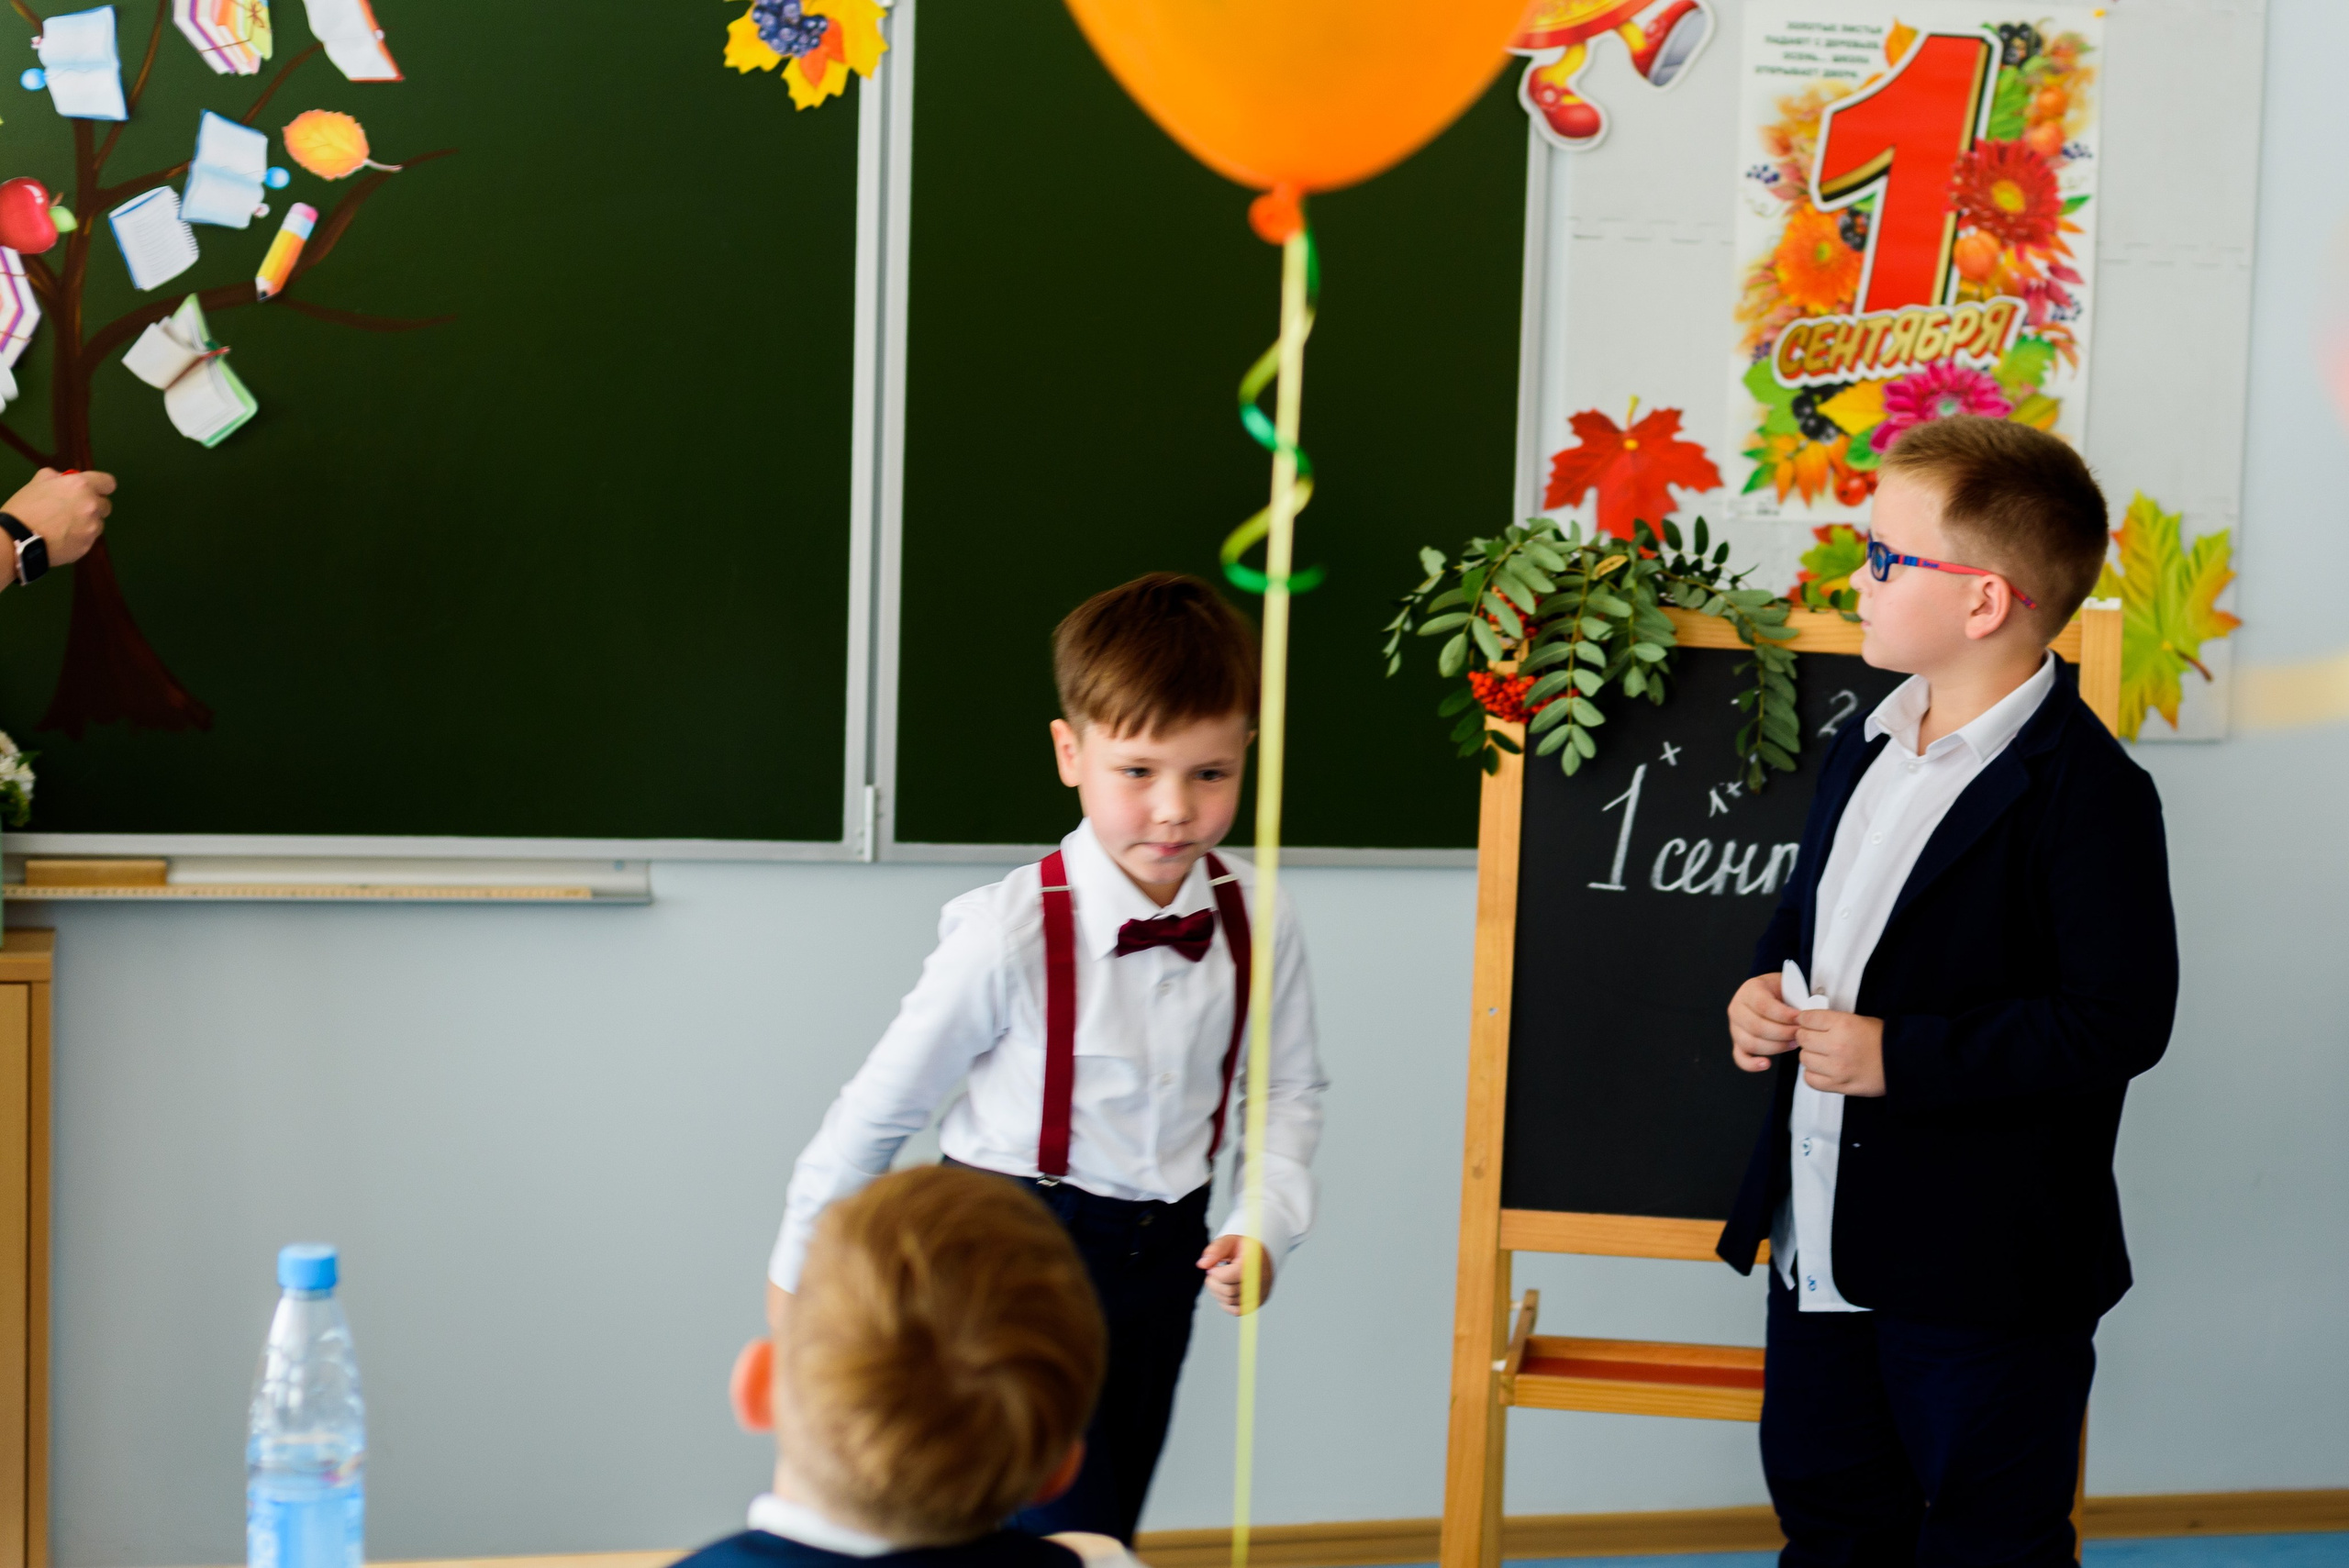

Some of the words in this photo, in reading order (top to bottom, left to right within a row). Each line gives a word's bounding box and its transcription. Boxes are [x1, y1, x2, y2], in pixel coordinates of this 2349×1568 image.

[1813, 29, 1993, 314] 1
[1777, 301, 2019, 381] СЕНТЯБРЯ
[1587, 762, 1648, 892] 1
